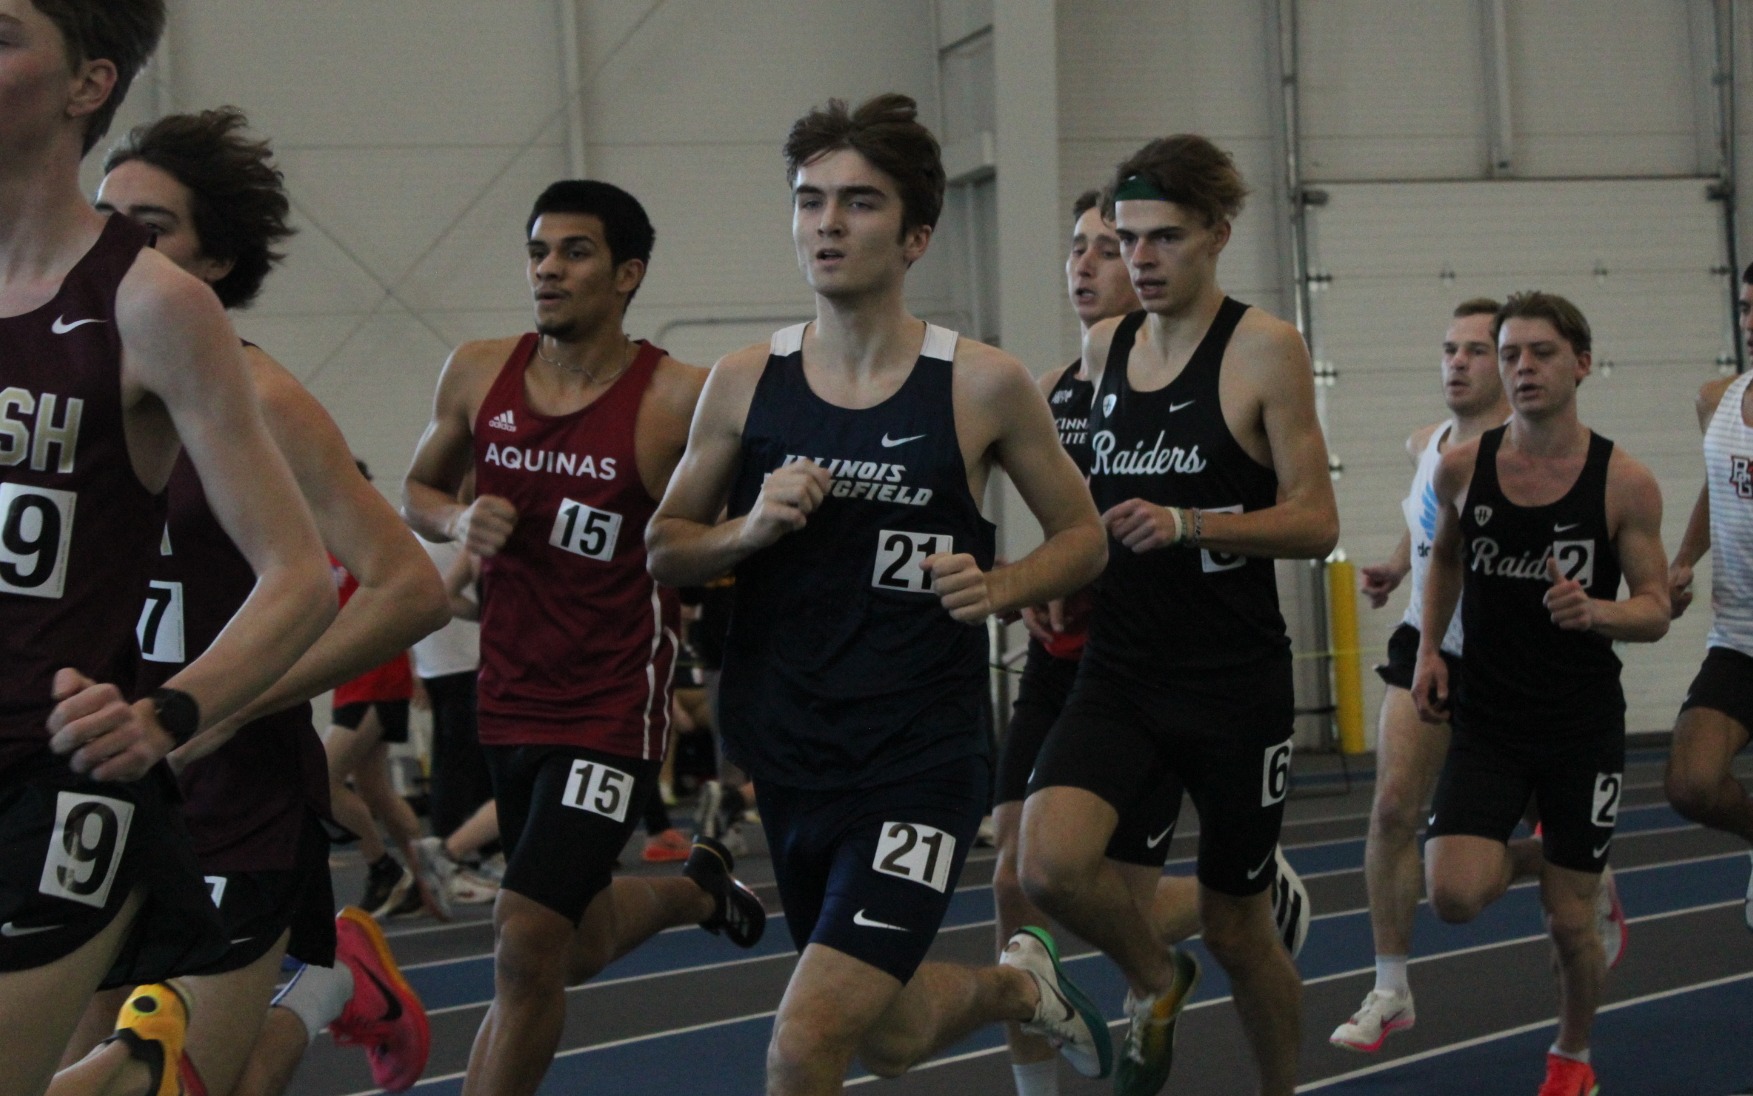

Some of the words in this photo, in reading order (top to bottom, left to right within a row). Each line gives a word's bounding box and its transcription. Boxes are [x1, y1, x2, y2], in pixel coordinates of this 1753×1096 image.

[0, 387, 84, 473] SH
[489, 419, 517, 432] adidas
[1059, 432, 1088, 444] LITE
[484, 442, 617, 481] AQUINAS
[780, 454, 907, 483] IINOIS
[1090, 430, 1207, 475] Raiders
[0, 494, 61, 588] 9
[564, 504, 611, 556] 15
[878, 534, 937, 590] 21
[1470, 536, 1555, 582] Raid
[1559, 545, 1589, 586] 2
[141, 587, 172, 655] 7
[575, 763, 624, 814] 15
[1268, 745, 1290, 799] 6
[1596, 777, 1619, 823] 2
[56, 801, 118, 895] 9
[879, 823, 943, 884] 21
